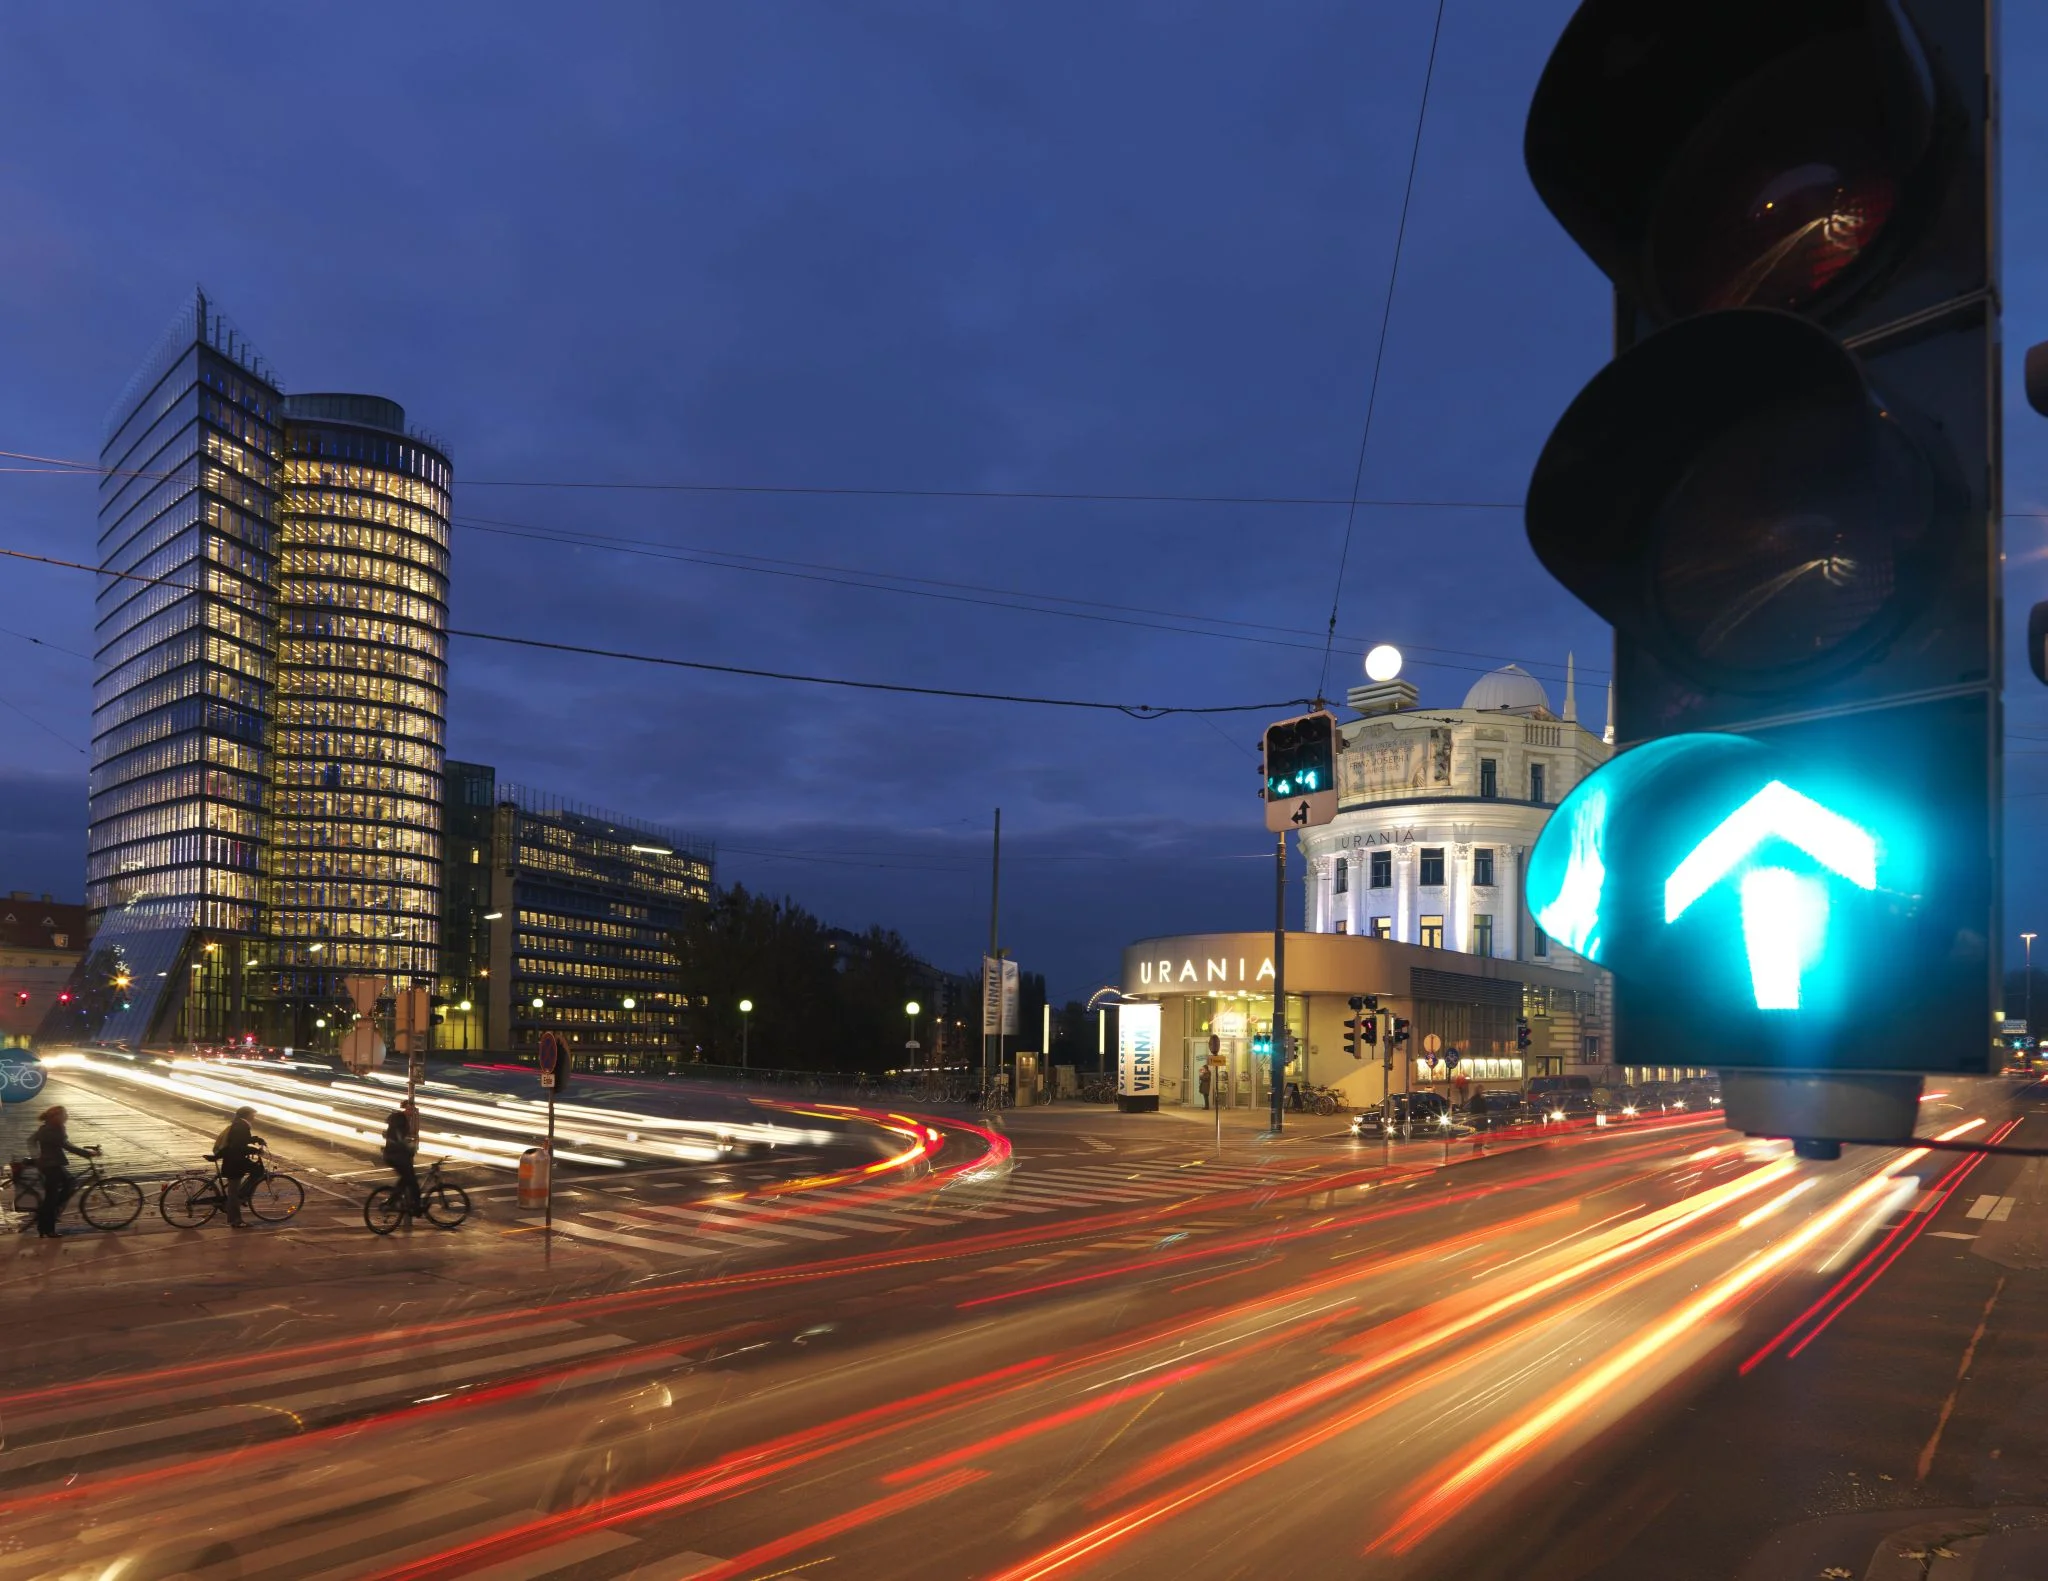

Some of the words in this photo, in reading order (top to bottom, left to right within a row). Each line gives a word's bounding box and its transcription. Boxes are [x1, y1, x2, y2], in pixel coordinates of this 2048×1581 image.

[1372, 755, 1404, 766] JOSEPH
[1341, 830, 1415, 849] URANIA
[1140, 957, 1275, 984] URANIA
